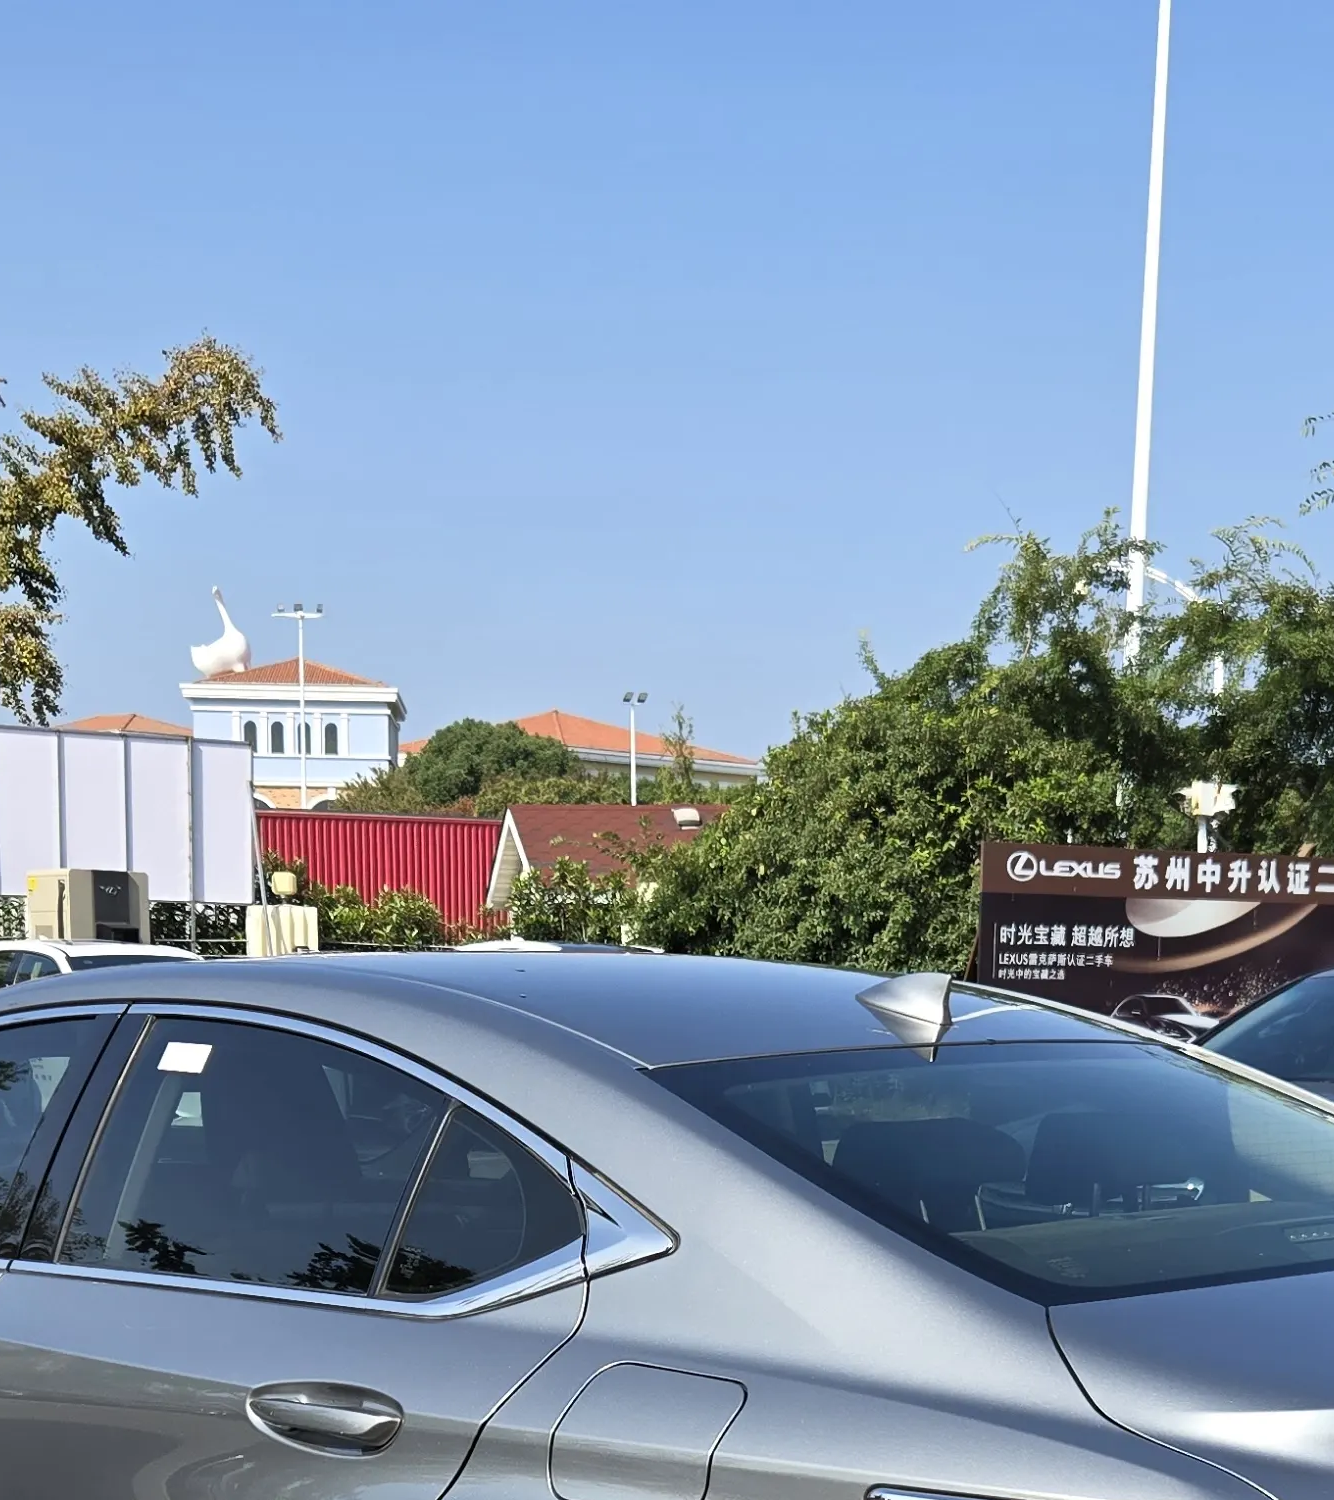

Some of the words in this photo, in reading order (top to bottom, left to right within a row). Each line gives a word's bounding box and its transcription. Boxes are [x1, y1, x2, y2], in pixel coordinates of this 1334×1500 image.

[1039, 859, 1123, 880] LEXUS
[999, 922, 1067, 947] 时光宝藏
[1070, 924, 1136, 948] 超越所想
